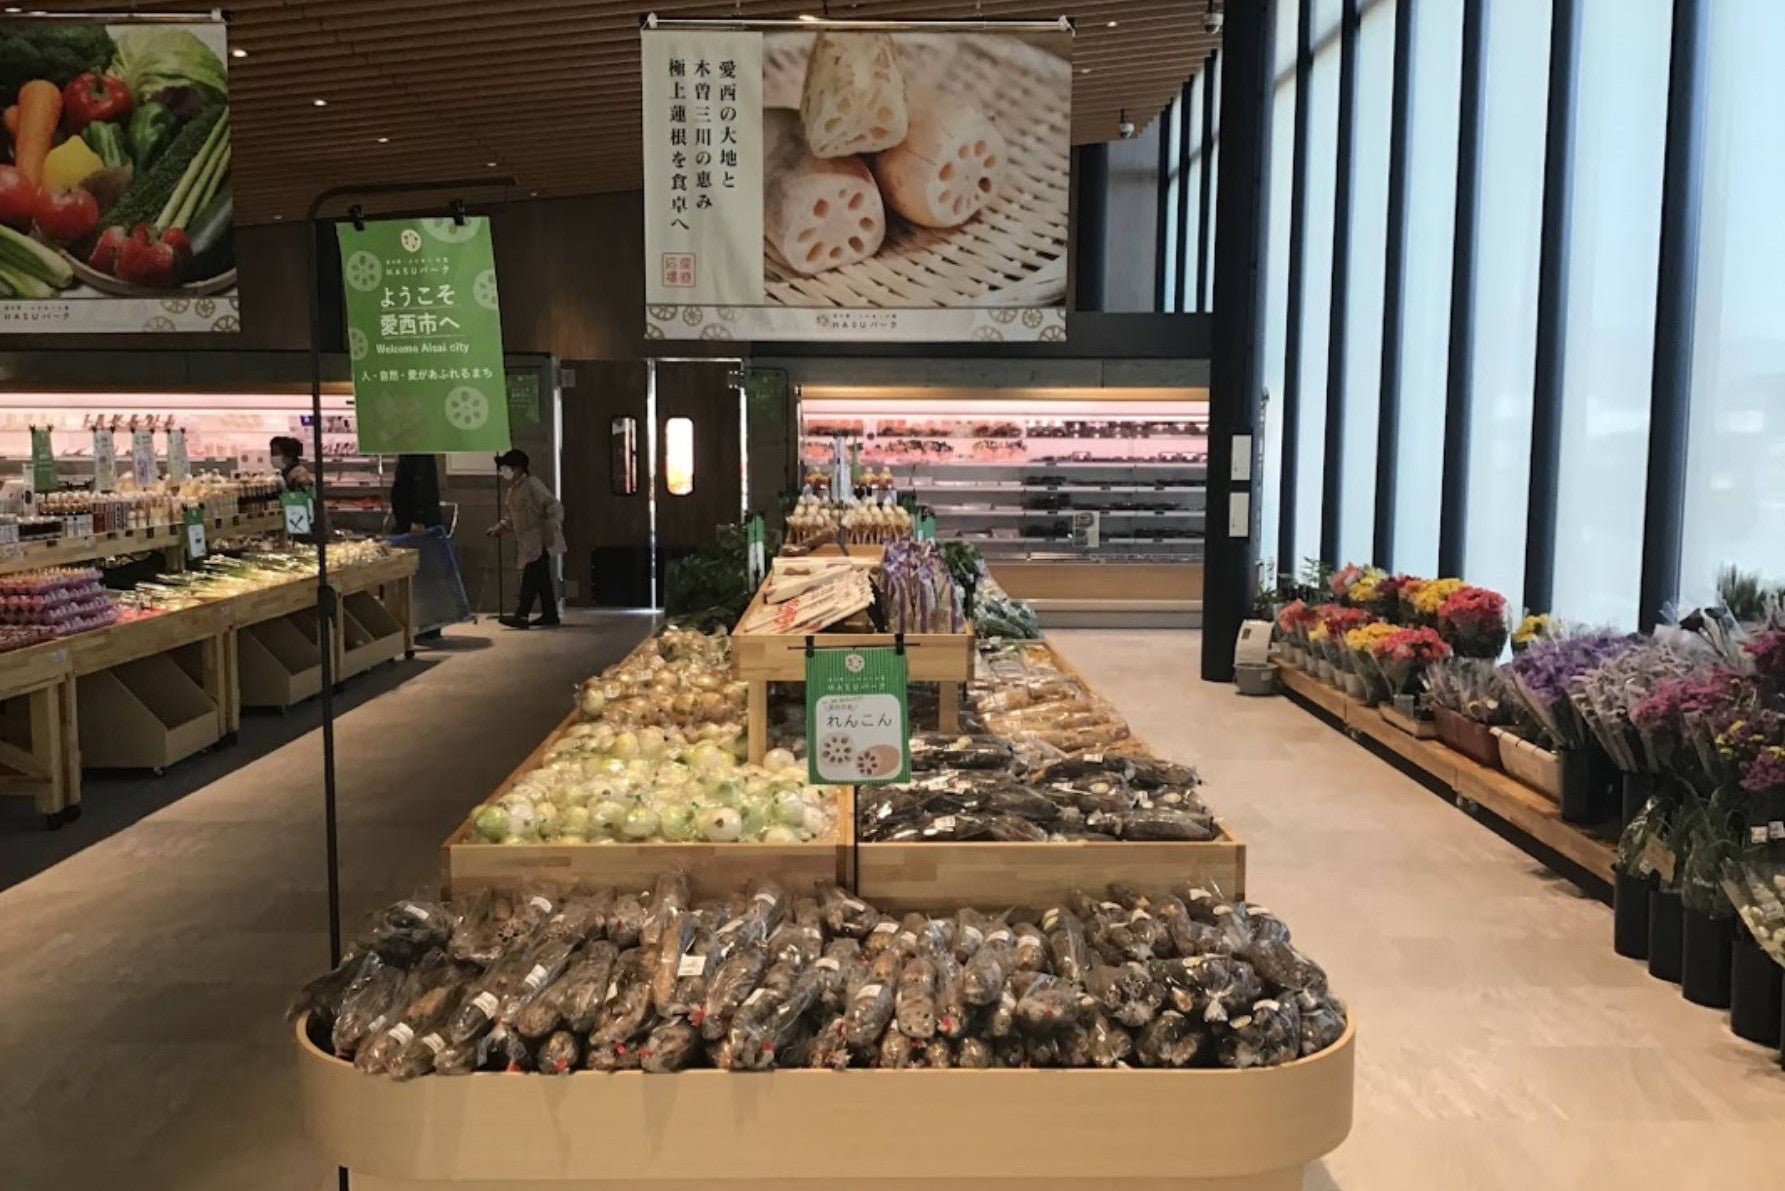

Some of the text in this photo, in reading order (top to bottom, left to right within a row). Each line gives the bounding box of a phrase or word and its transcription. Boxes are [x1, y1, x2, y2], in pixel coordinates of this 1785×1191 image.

[694, 59, 713, 210] 木曽三川の恵み
[718, 59, 738, 189] 愛西の大地と
[668, 58, 690, 231] 極上蓮根を食卓へ
[380, 284, 456, 308] ようこそ
[380, 312, 460, 336] 愛西市へ
[376, 341, 470, 354] Welcome Aisai city
[826, 713, 893, 729] れんこん
